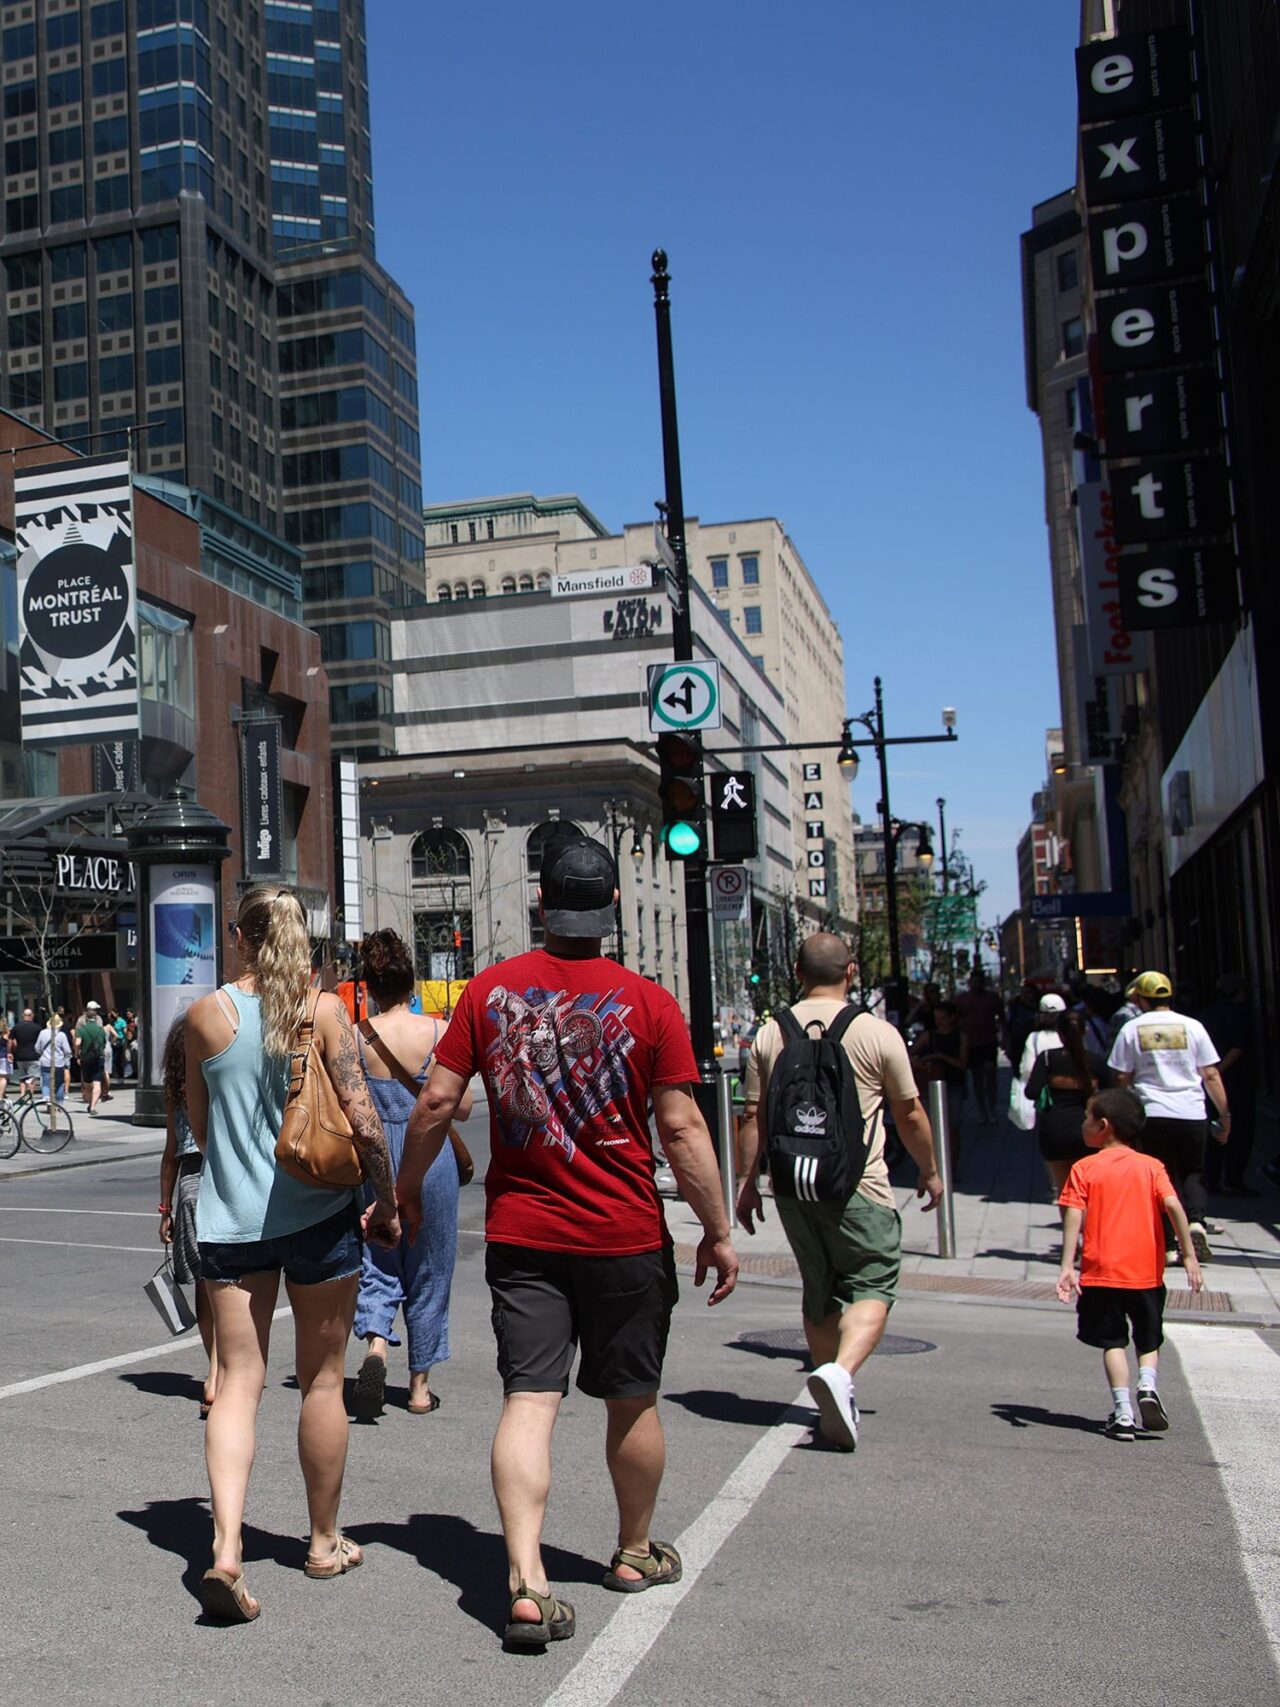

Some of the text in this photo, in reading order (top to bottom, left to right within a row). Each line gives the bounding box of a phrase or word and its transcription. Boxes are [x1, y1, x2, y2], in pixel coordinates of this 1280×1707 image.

[1091, 53, 1179, 608] experts
[57, 576, 91, 589] PLACE
[557, 575, 624, 592] Mansfield
[28, 585, 122, 611] MONTRÉAL
[49, 608, 101, 627] TRUST
[259, 771, 269, 800] cadeaux
[806, 764, 825, 896] EATON
[257, 829, 272, 860] Indigo
[56, 853, 120, 890] PLACE
[1032, 899, 1061, 914] Bell
[603, 1137, 630, 1147] HONDA
